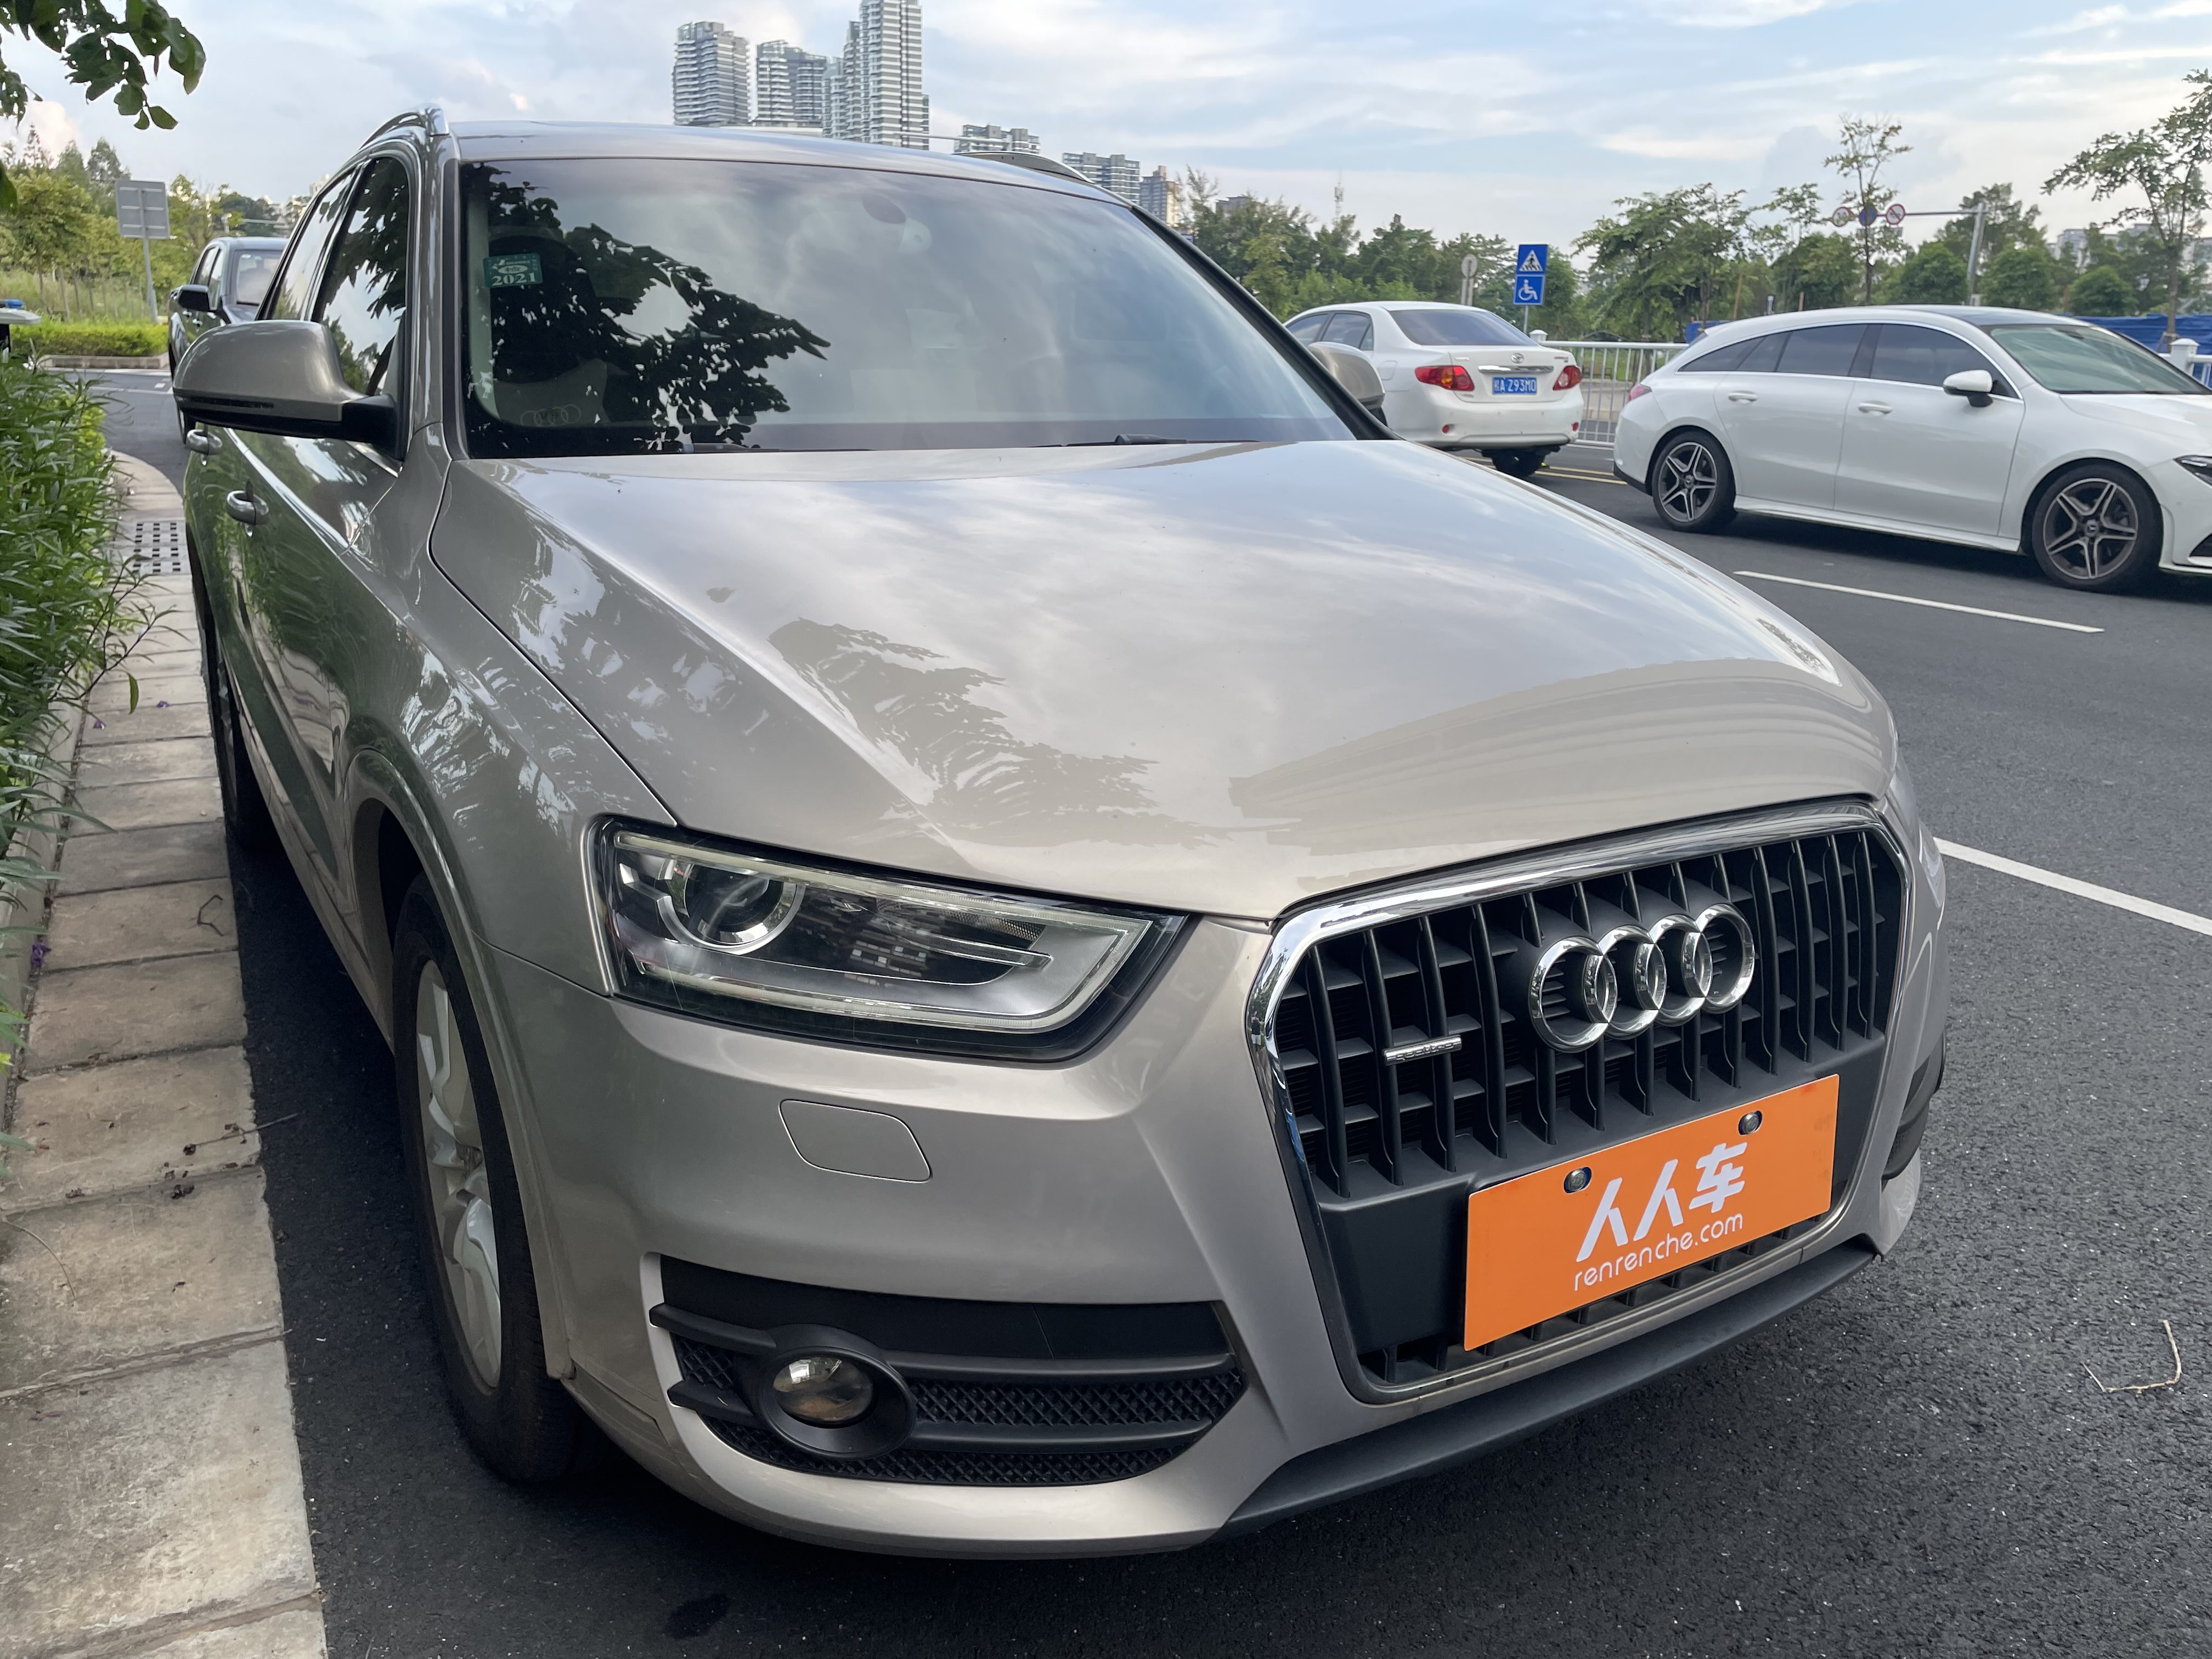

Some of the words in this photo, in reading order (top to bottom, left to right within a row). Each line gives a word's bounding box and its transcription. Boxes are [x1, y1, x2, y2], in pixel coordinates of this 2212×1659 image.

[492, 272, 536, 285] 2021
[1577, 1142, 1747, 1262] 人人车
[1575, 1213, 1742, 1291] renrenche.com
